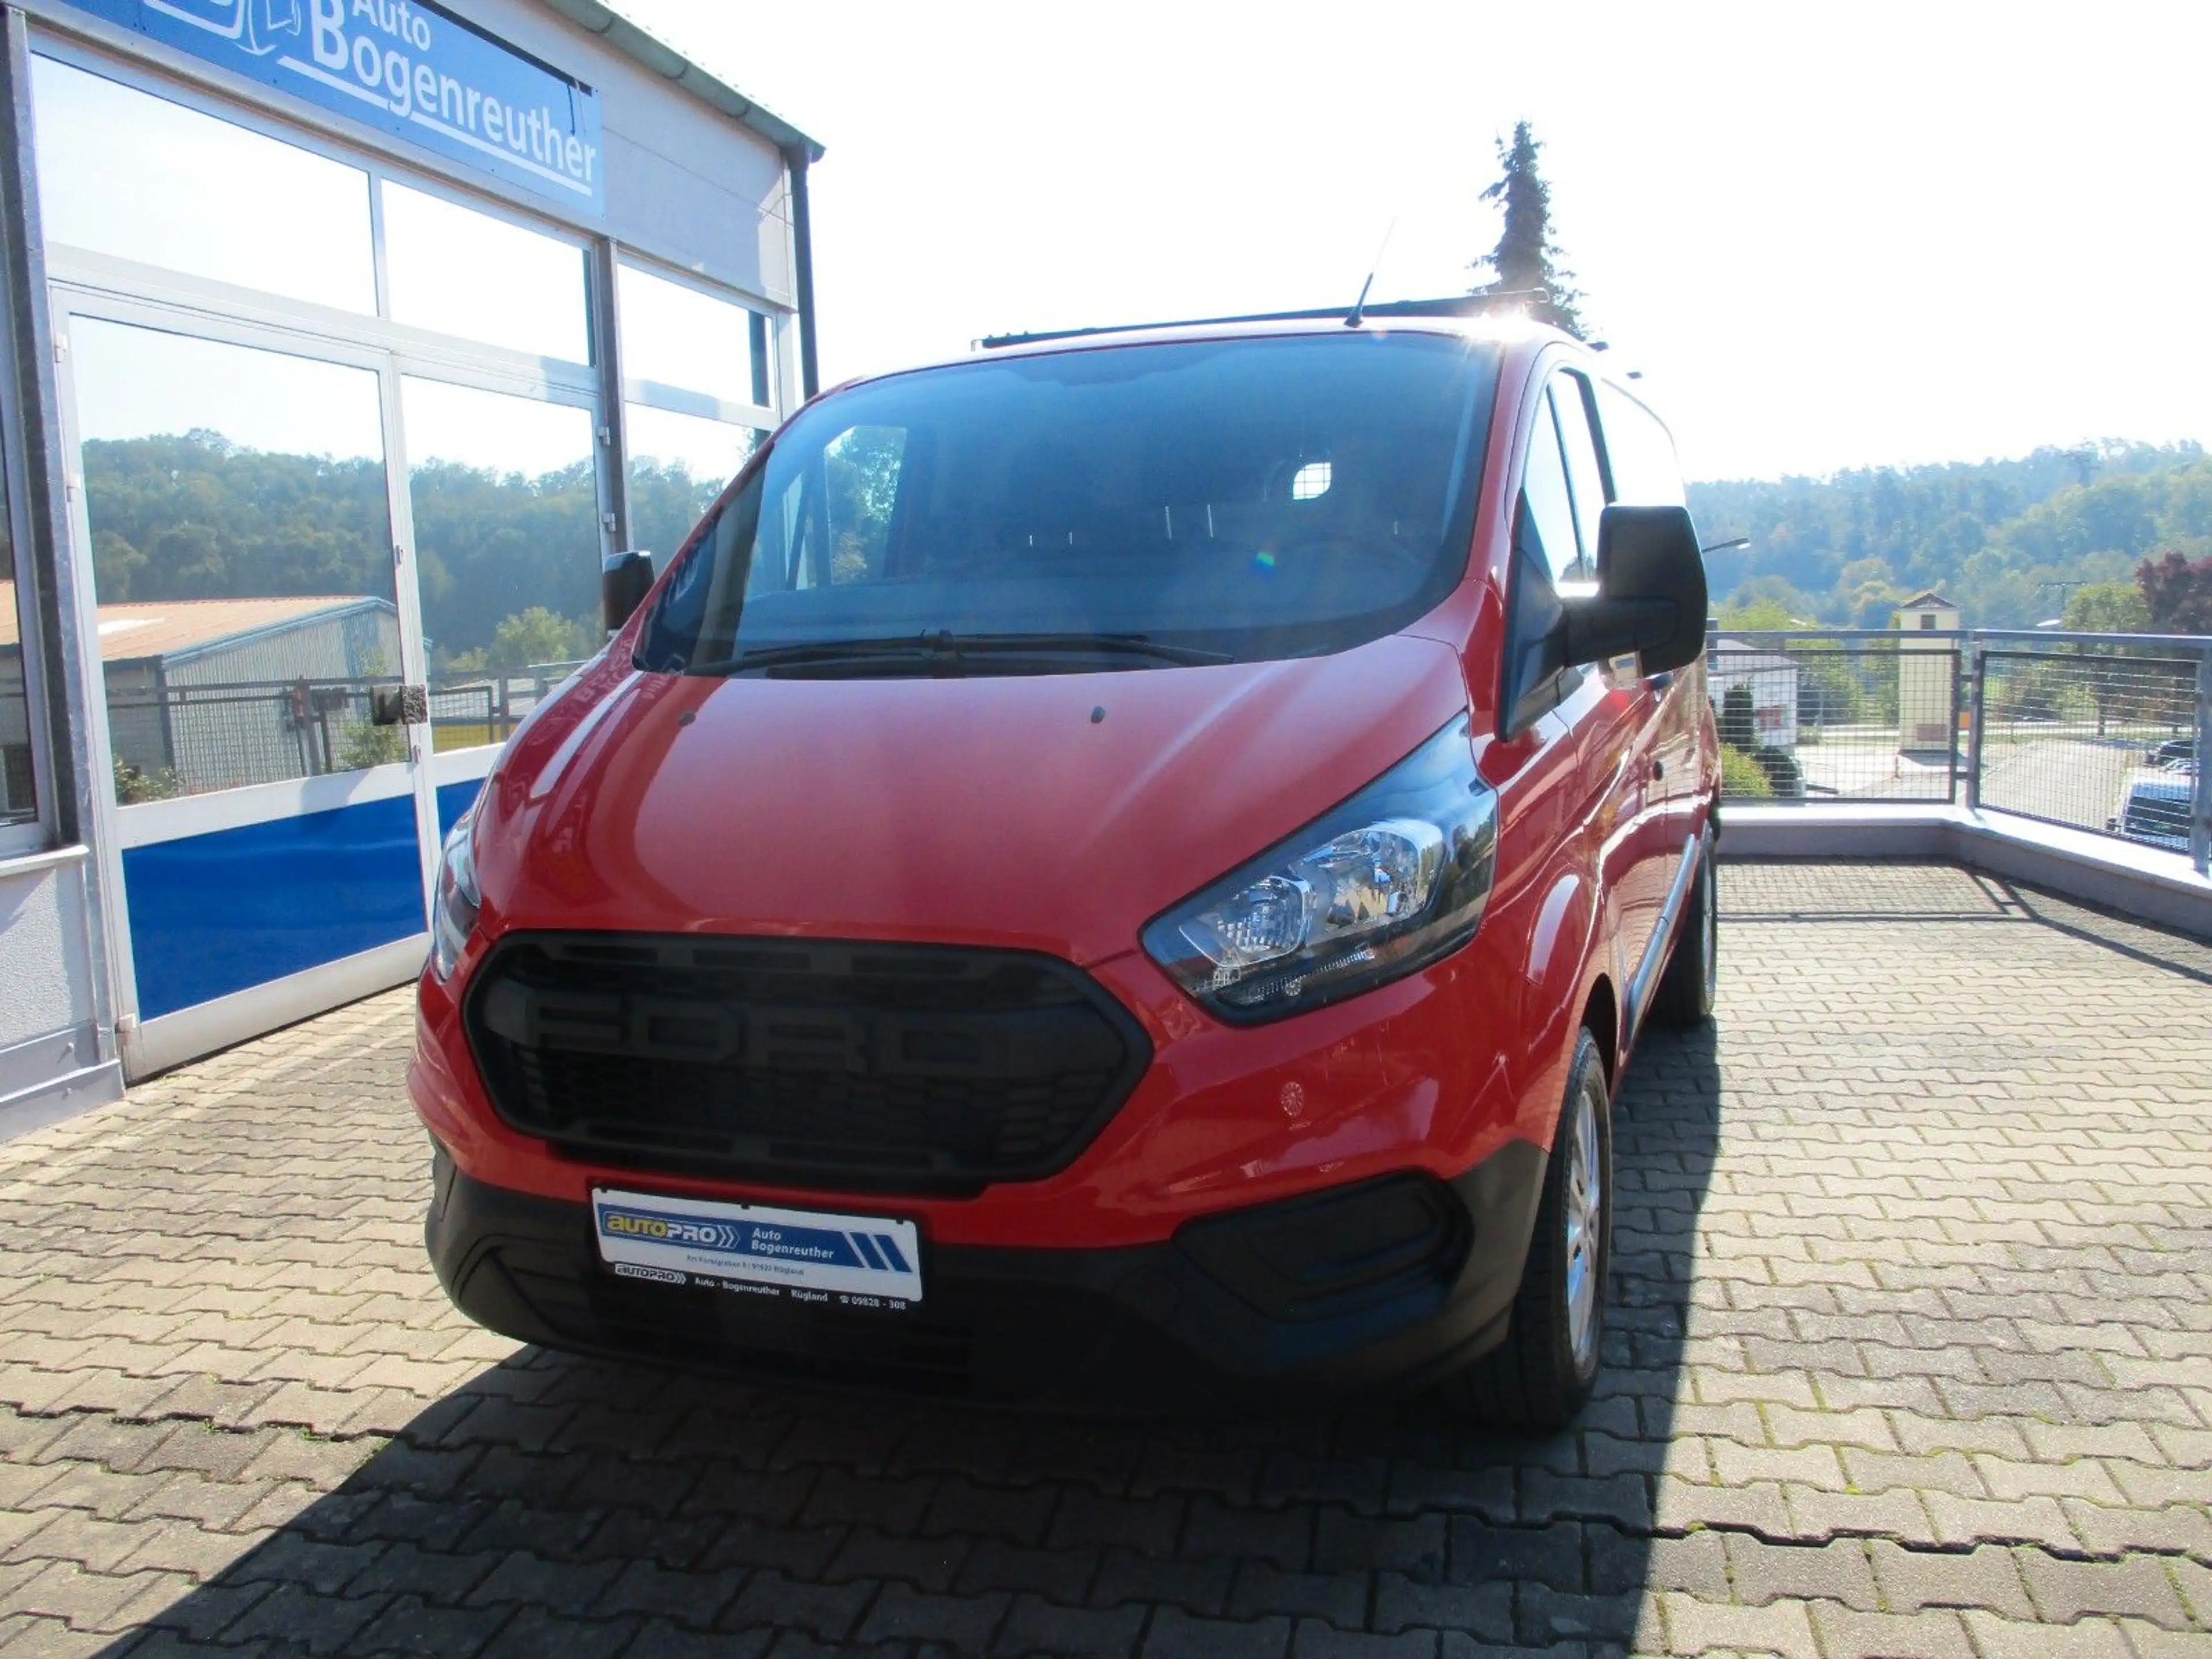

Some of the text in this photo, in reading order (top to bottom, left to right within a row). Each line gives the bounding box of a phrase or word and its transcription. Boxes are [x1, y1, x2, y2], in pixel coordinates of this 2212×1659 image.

[351, 0, 431, 51] Auto
[309, 0, 596, 182] Bogenreuther
[752, 1228, 781, 1240] Auto
[751, 1240, 835, 1259] Bogenreuther
[695, 1277, 715, 1287] Auto
[722, 1279, 780, 1296] Bogenreuther
[791, 1289, 828, 1302] Rügland
